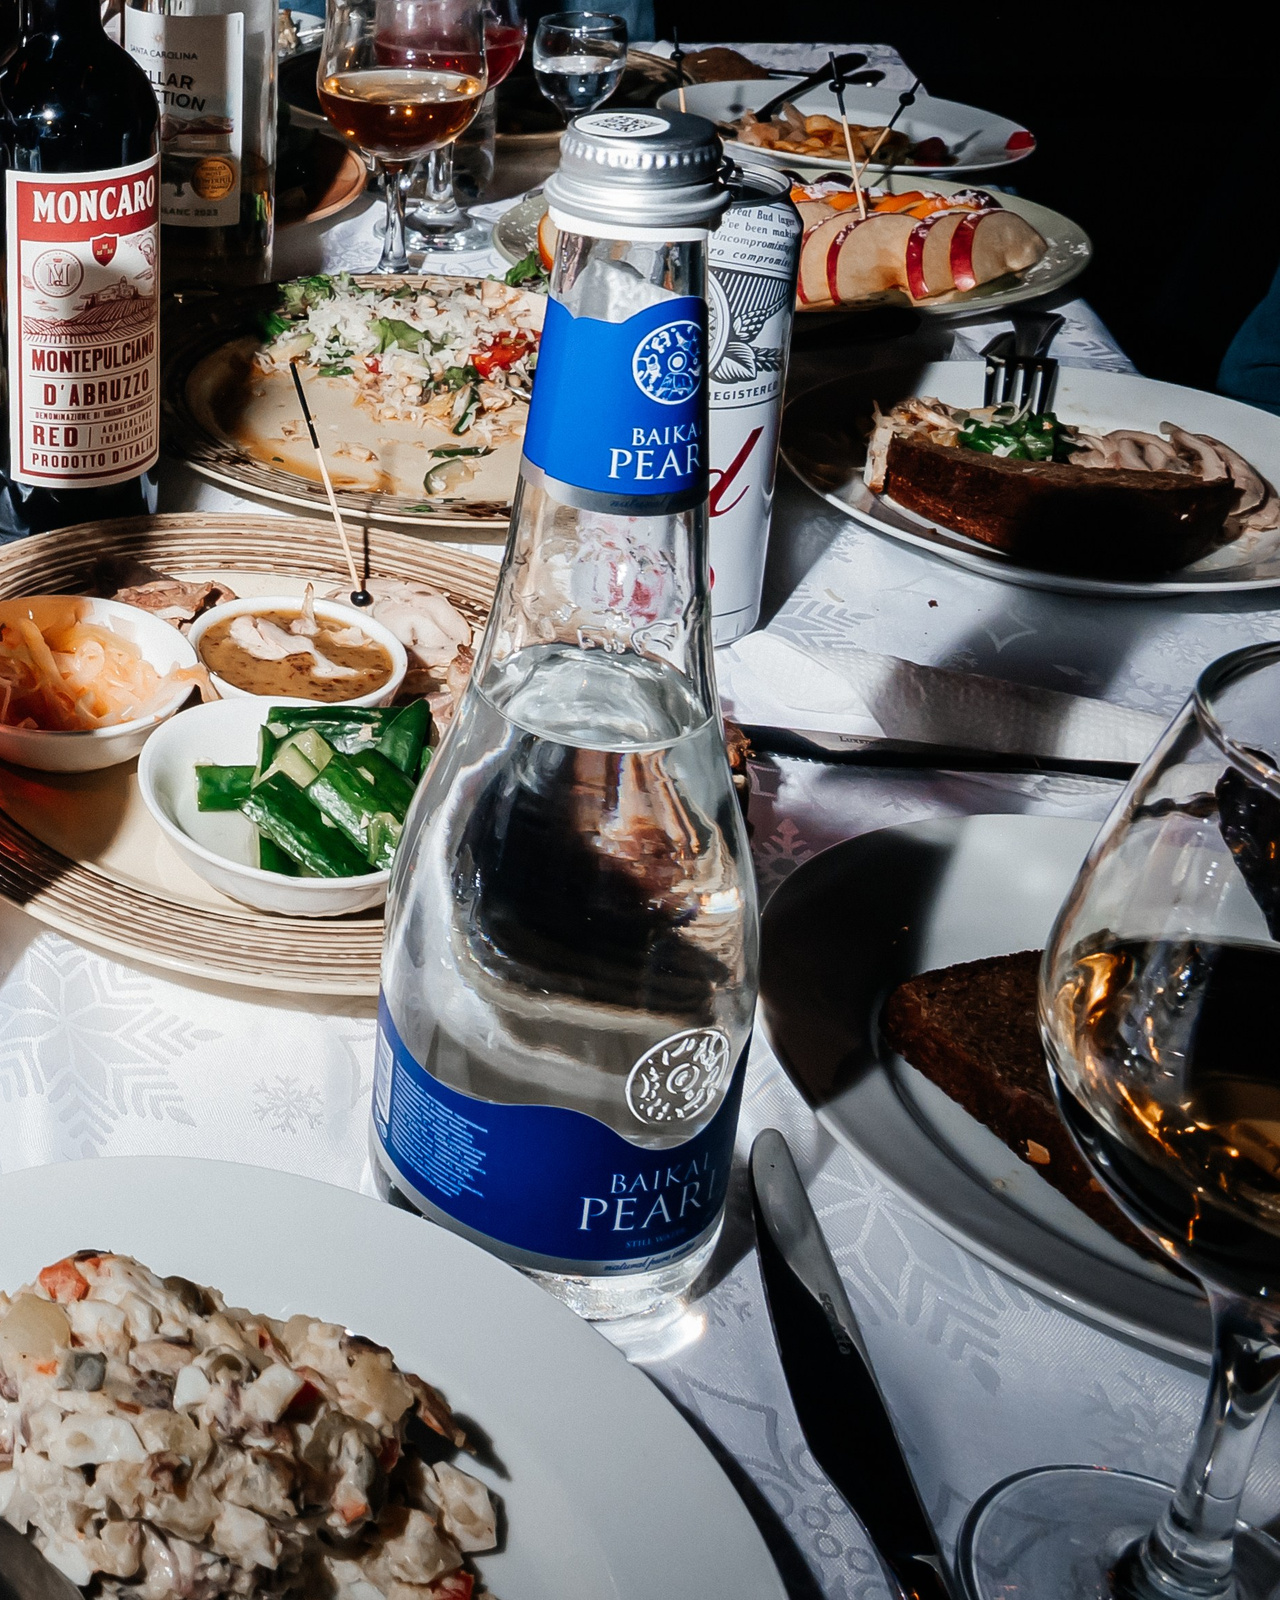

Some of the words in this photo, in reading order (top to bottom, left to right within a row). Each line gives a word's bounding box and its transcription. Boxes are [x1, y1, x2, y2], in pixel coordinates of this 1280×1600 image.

[130, 43, 148, 56] SANTA
[150, 49, 198, 60] CAROLINA
[145, 70, 194, 91] LLAR
[154, 89, 205, 112] TION
[32, 174, 155, 224] MONCARO
[726, 207, 752, 218] great
[757, 209, 773, 222] Bud
[745, 222, 768, 234] been
[772, 229, 796, 239] makin
[710, 247, 724, 256] ro
[32, 331, 154, 373] MONTEPULCIANO
[44, 368, 149, 407] D'ABRUZZO
[35, 411, 90, 421] DENOMINAZIONE
[33, 425, 78, 447] RED
[32, 453, 106, 469] PRODOTTO
[112, 435, 153, 464] D'ITALIA
[608, 443, 700, 481] PEAR
[626, 1238, 651, 1248] STILL
